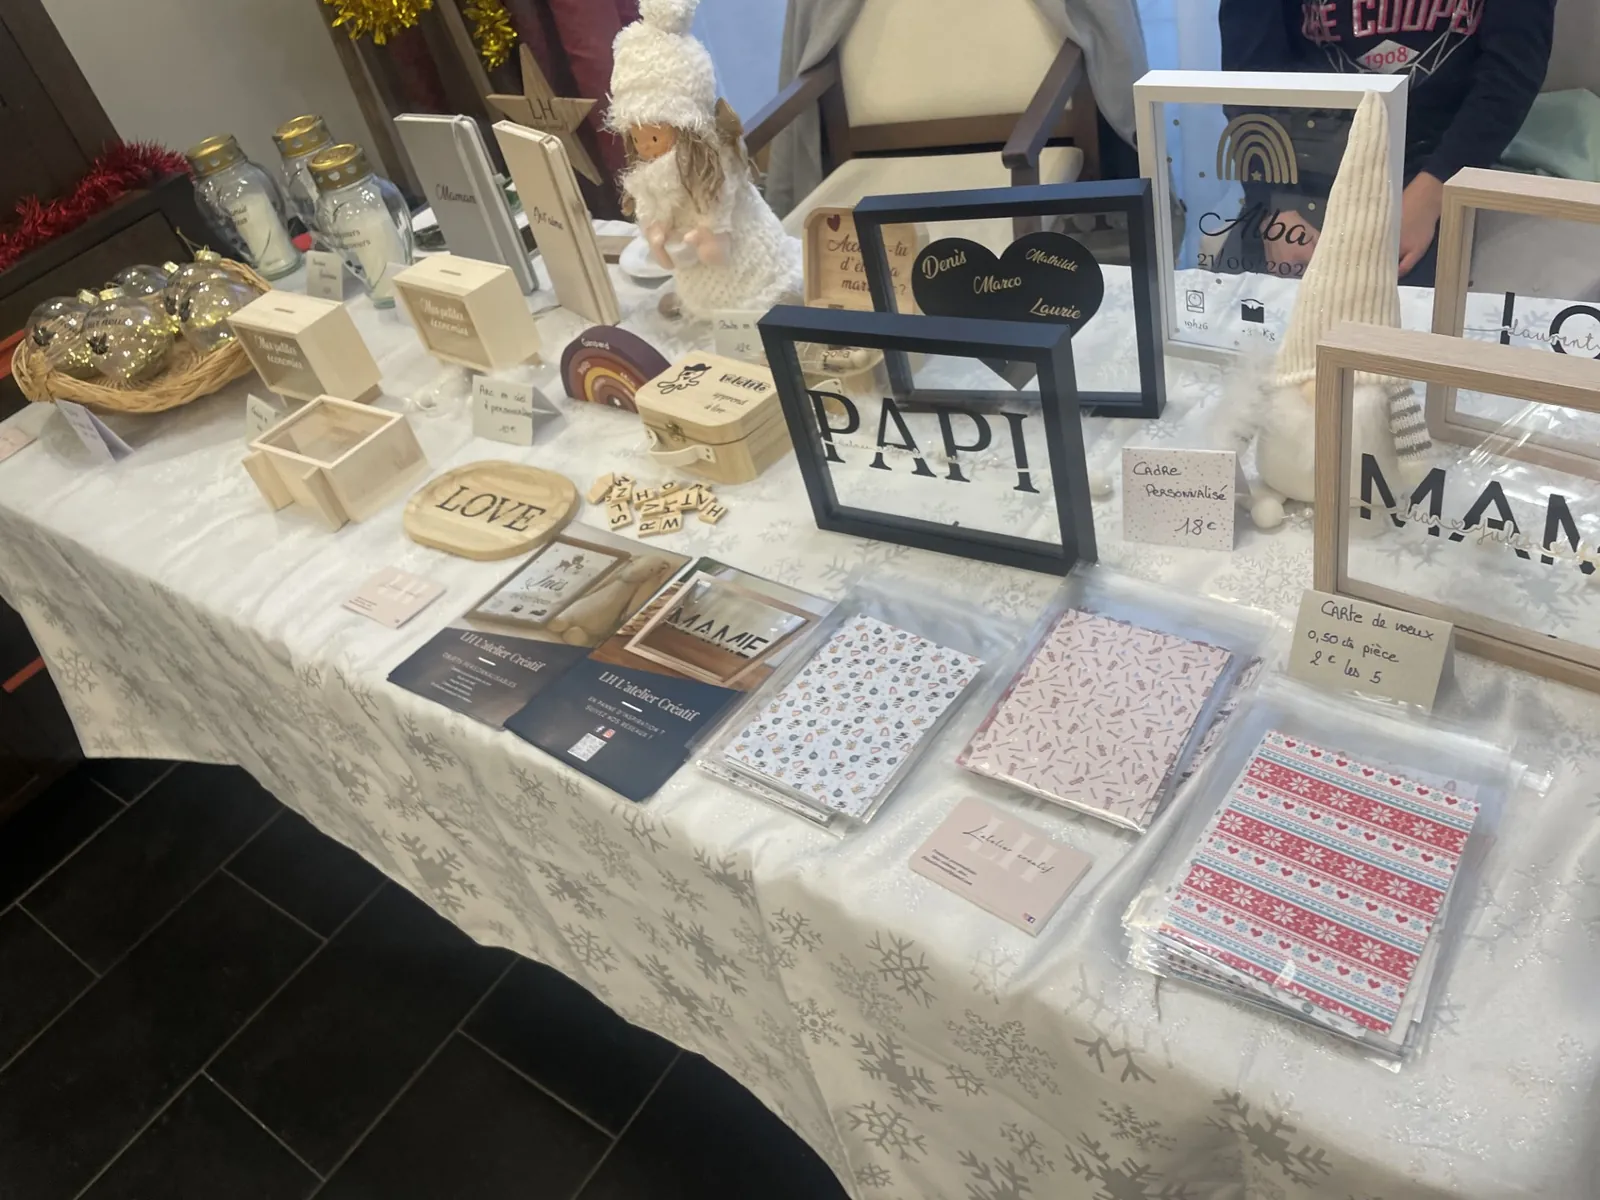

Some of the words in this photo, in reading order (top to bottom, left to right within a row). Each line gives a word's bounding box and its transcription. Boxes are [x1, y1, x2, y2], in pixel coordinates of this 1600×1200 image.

[1365, 46, 1408, 69] 1908
[526, 98, 558, 120] LH
[1198, 201, 1314, 246] Alba
[922, 249, 968, 280] Denis
[1025, 248, 1080, 273] Mathilde
[973, 275, 1023, 294] Marco
[1028, 297, 1082, 320] Laurie
[804, 389, 1041, 495] PAPI
[435, 484, 547, 532] LOVE
[1371, 612, 1388, 629] de
[1307, 629, 1339, 645] 0,50
[1362, 643, 1400, 663] pièce
[1343, 658, 1360, 678] les
[1369, 670, 1382, 684] 5
[598, 671, 619, 686] LH
[615, 678, 659, 704] L'atelier
[657, 697, 701, 722] Créatif
